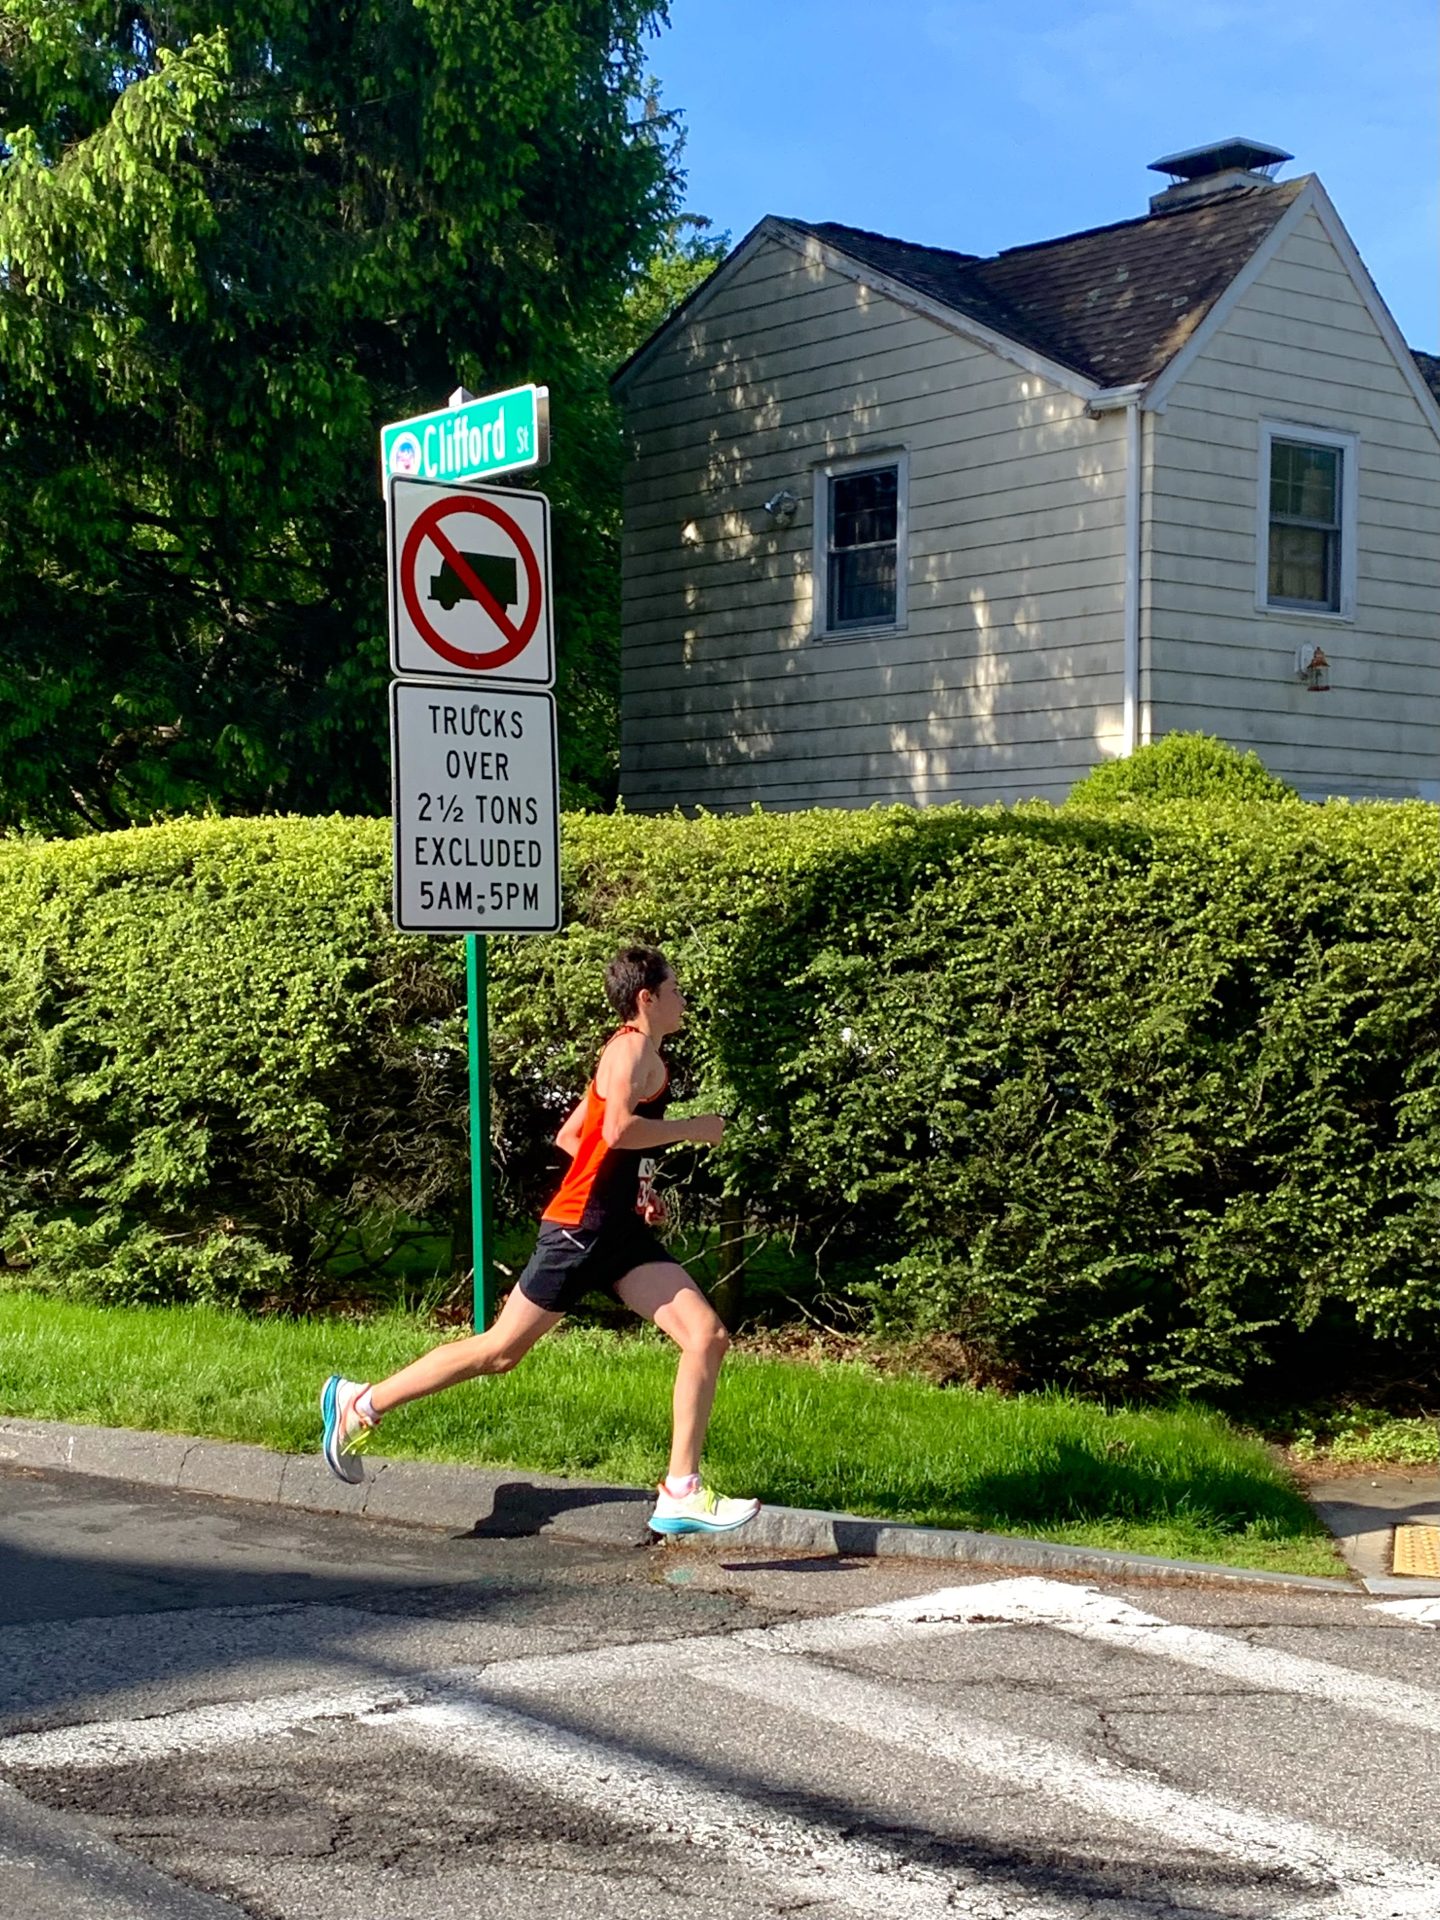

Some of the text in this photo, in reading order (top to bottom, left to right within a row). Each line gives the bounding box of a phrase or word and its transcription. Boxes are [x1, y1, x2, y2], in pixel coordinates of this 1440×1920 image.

[423, 404, 529, 478] Clifford St
[428, 705, 524, 739] TRUCKS
[446, 750, 509, 781] OVER
[475, 795, 538, 825] TONS
[415, 836, 542, 868] EXCLUDED
[420, 881, 539, 911] 5AM-5PM
